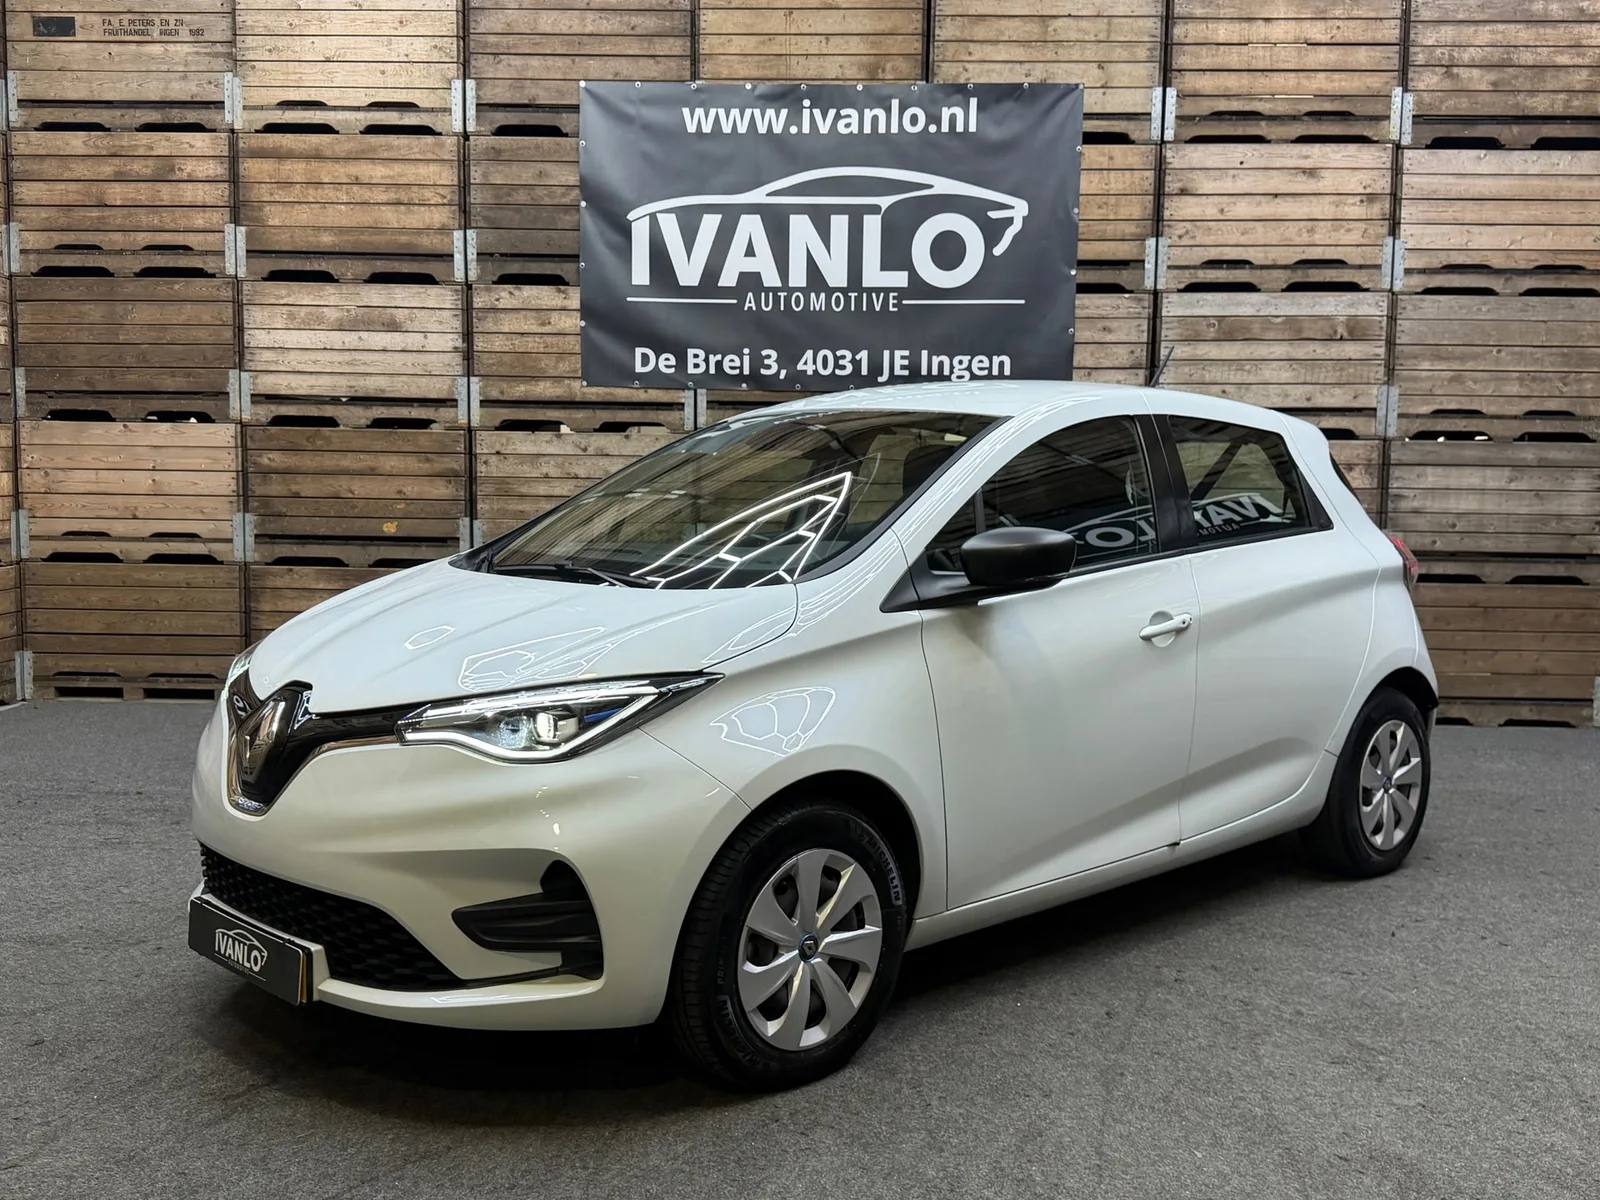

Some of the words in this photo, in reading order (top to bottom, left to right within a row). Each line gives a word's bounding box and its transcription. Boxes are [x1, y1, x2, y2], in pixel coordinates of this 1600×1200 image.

[102, 19, 115, 27] FA.
[127, 18, 156, 27] PETERS
[160, 18, 170, 27] EN
[103, 28, 152, 37] FRUITHANDEL
[188, 28, 205, 37] 1992
[682, 98, 978, 135] www.ivanlo.nl
[631, 212, 986, 289] IVANLO
[744, 292, 899, 312] AUTOMOTIVE
[635, 347, 677, 374] De
[687, 347, 750, 375] Brei
[760, 349, 787, 380] 3,
[797, 349, 869, 376] 4031
[877, 350, 910, 383] JE
[921, 350, 1012, 382] Ingen
[215, 932, 262, 973] IVANLO
